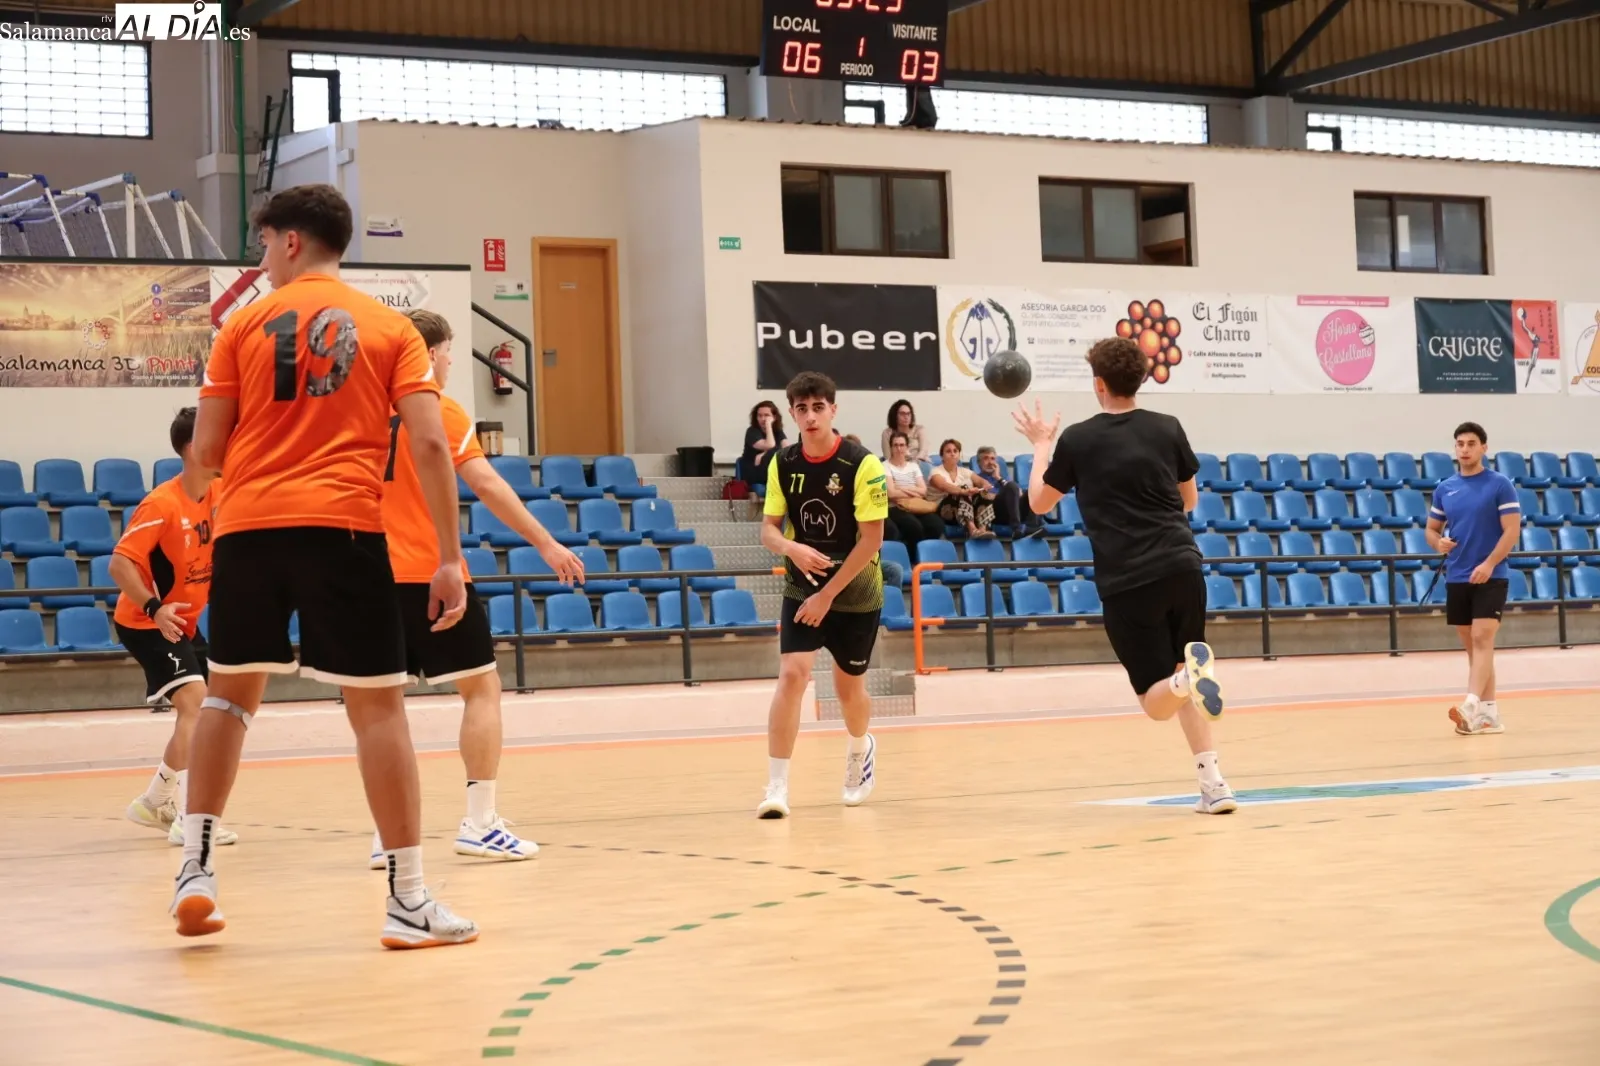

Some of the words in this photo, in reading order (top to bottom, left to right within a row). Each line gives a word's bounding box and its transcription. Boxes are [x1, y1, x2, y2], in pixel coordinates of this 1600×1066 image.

[773, 16, 821, 33] LOCAL
[892, 24, 938, 41] VISITANTE
[782, 41, 822, 74] 06
[840, 63, 874, 76] PERIODO
[901, 49, 939, 82] 03
[376, 292, 411, 307] ORÍA
[1090, 305, 1107, 313] DOS
[1192, 301, 1211, 321] El
[1217, 303, 1258, 325] Figón
[756, 321, 937, 351] Pubeer
[1203, 324, 1251, 344] Charro
[1322, 317, 1357, 344] Horno
[262, 307, 359, 402] 19
[1318, 344, 1373, 374] Castellano
[1428, 336, 1504, 362] CHIGRE
[146, 354, 197, 373] Print
[790, 473, 805, 494] 77
[193, 519, 211, 548] 10
[803, 511, 830, 535] PLAY
